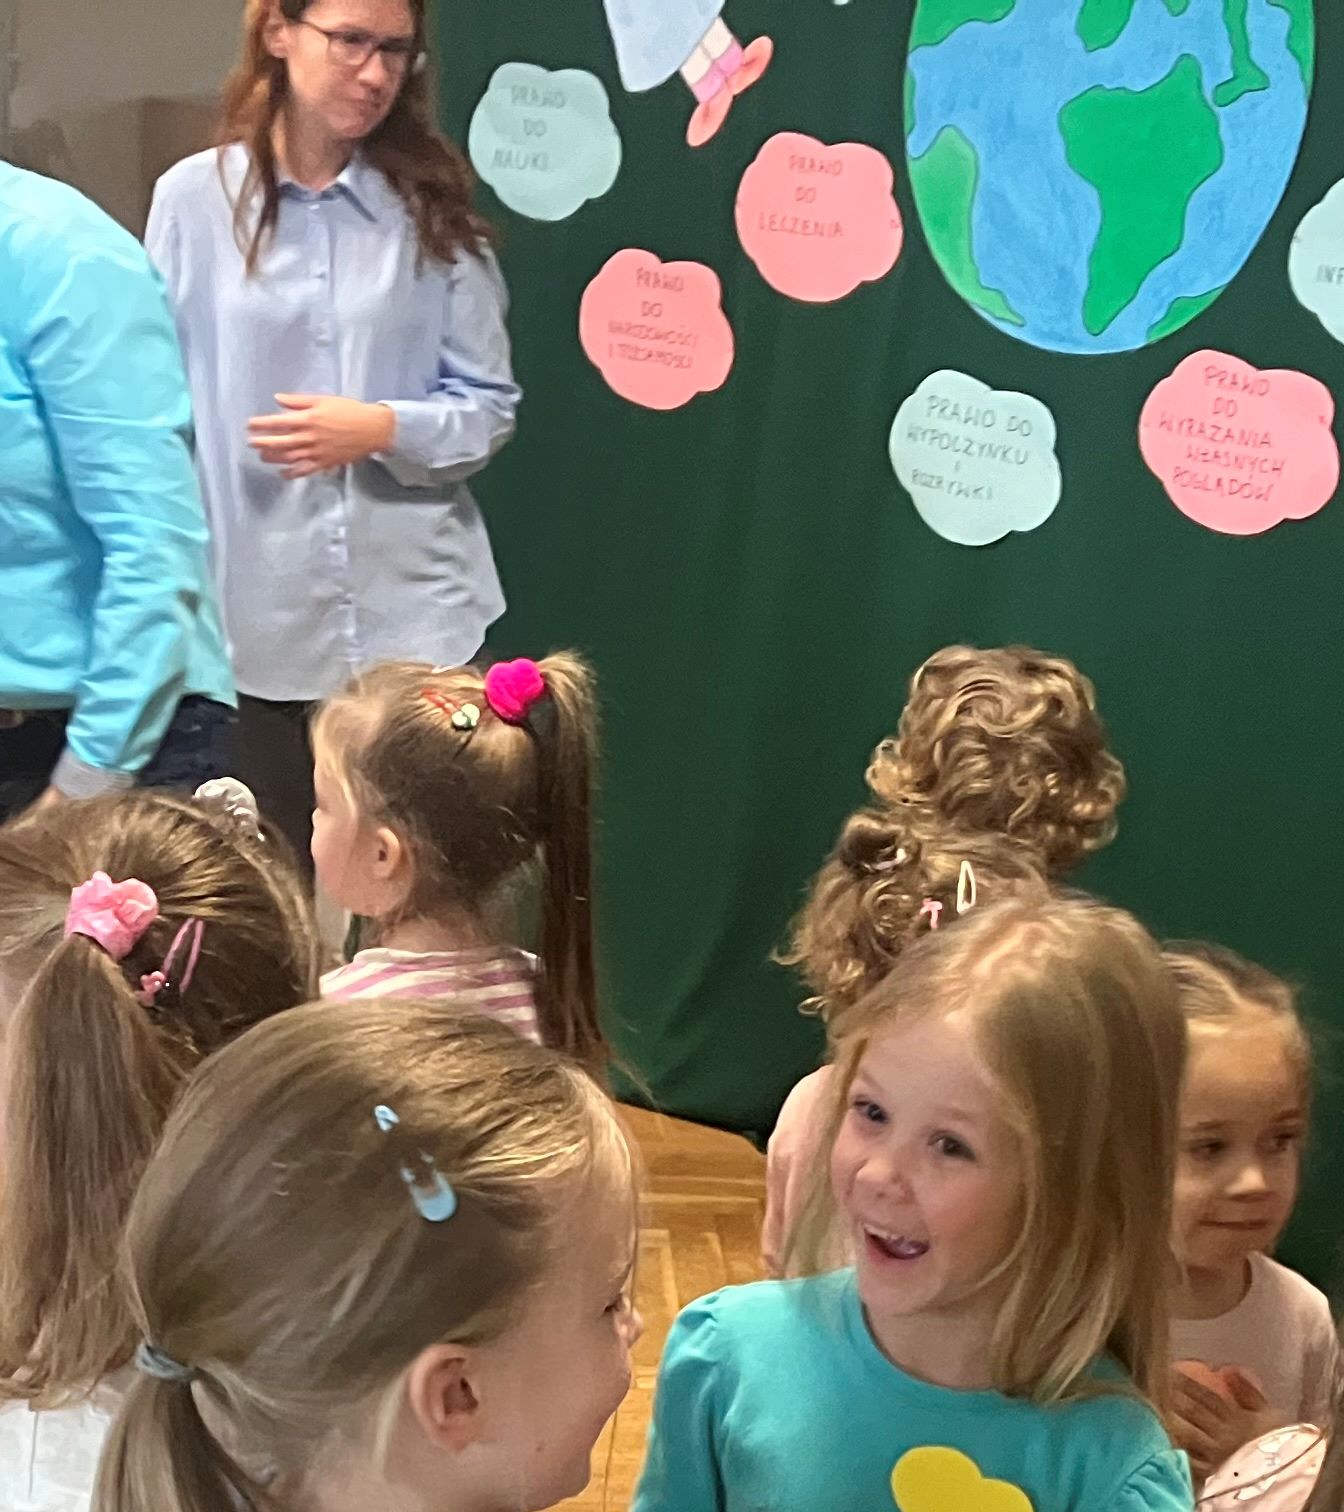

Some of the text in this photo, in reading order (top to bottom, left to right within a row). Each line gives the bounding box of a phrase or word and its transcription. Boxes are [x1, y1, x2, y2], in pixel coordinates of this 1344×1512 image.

[758, 212, 843, 238] LECZENIA
[1203, 365, 1271, 396] PRAWO
[927, 395, 1033, 437] PRAWO DO
[1212, 397, 1238, 418] DO
